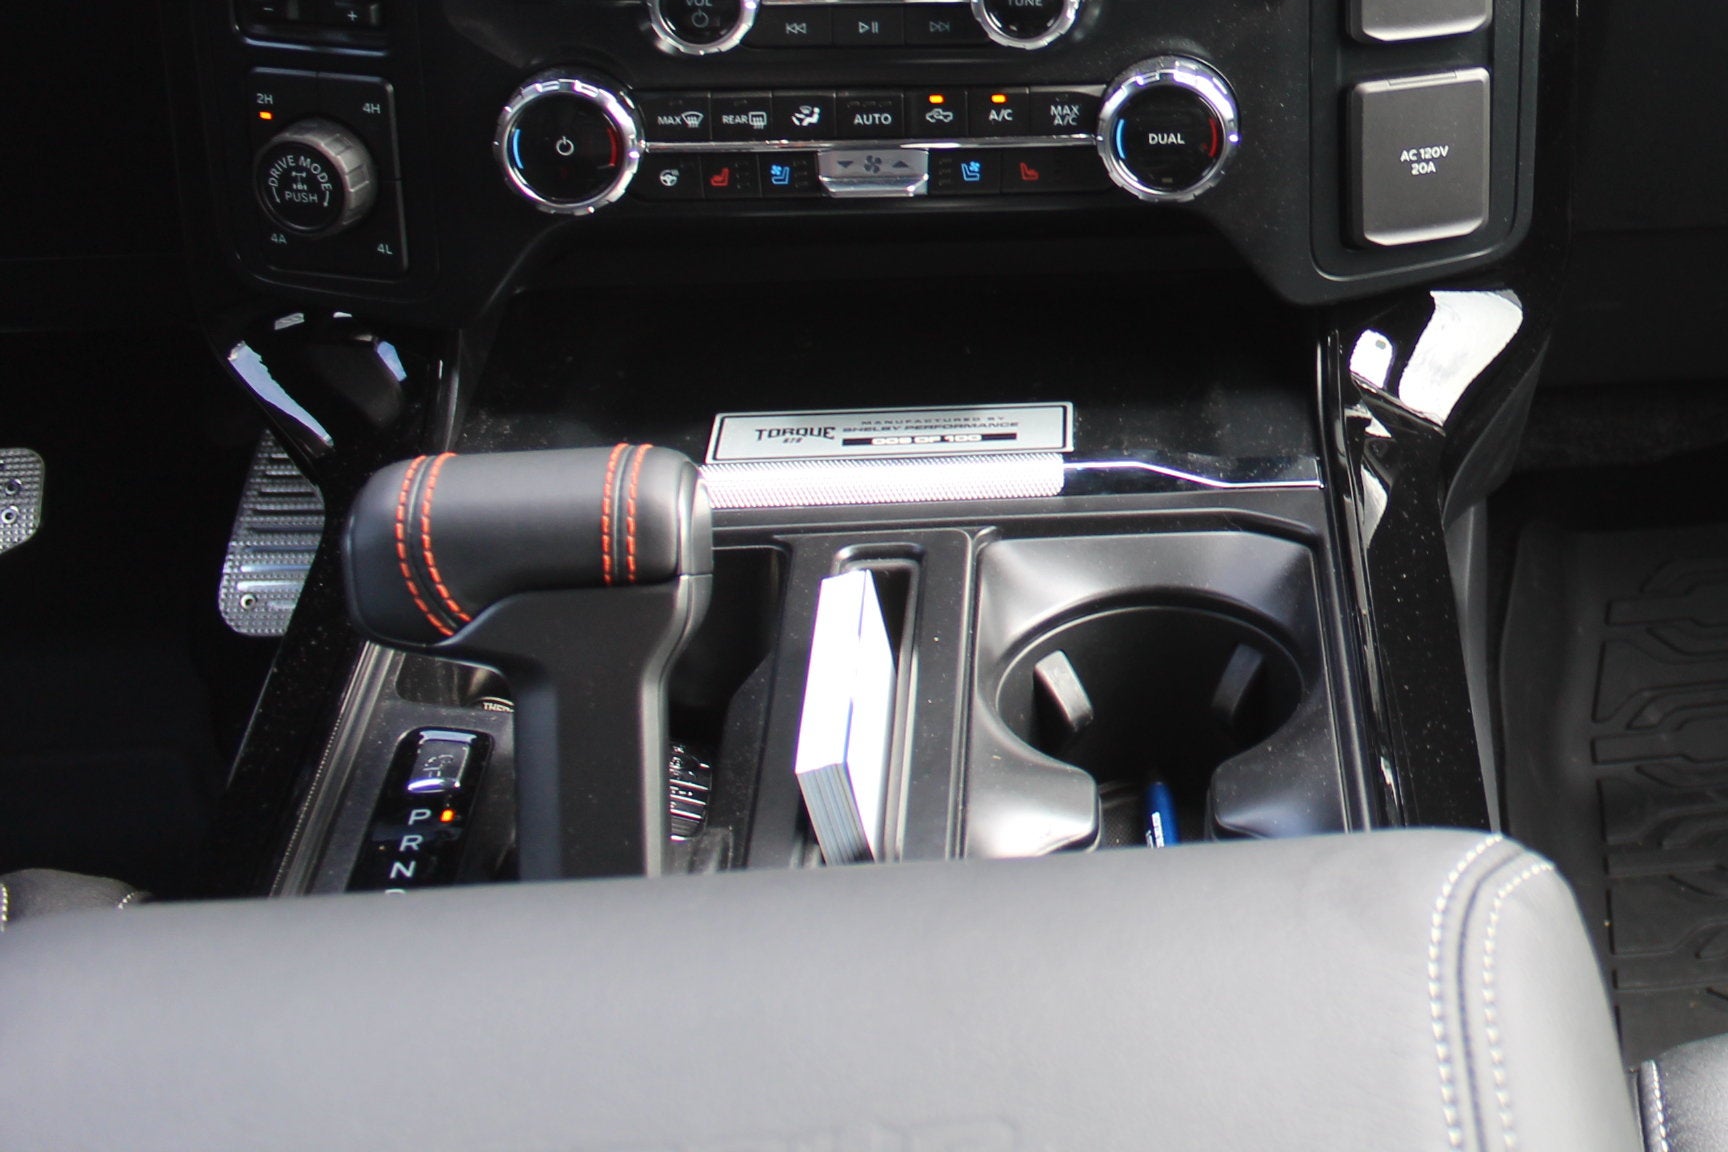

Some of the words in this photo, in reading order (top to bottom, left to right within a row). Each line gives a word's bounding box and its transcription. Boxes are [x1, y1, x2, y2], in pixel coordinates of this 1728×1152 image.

[256, 93, 273, 104] 2H
[362, 102, 381, 114] 4H
[1050, 105, 1080, 116] MAX
[658, 114, 682, 126] MAX
[722, 114, 748, 125] REAR
[853, 112, 892, 125] AUTO
[989, 109, 1013, 122] A/C
[1053, 114, 1078, 127] A/C
[1148, 133, 1185, 145] DUAL
[1400, 149, 1418, 163] AC
[1419, 146, 1448, 160] 120V
[268, 155, 295, 187] DRIVE
[299, 156, 332, 191] MODE
[1411, 162, 1436, 175] 20A
[285, 191, 318, 203] PUSH
[270, 233, 287, 244] 4A
[377, 243, 393, 255] 4L
[904, 422, 1019, 430] PERFORMANCE
[755, 426, 836, 441] TORQUE
[408, 809, 431, 826] P
[399, 835, 423, 851] R
[389, 861, 416, 879] N
